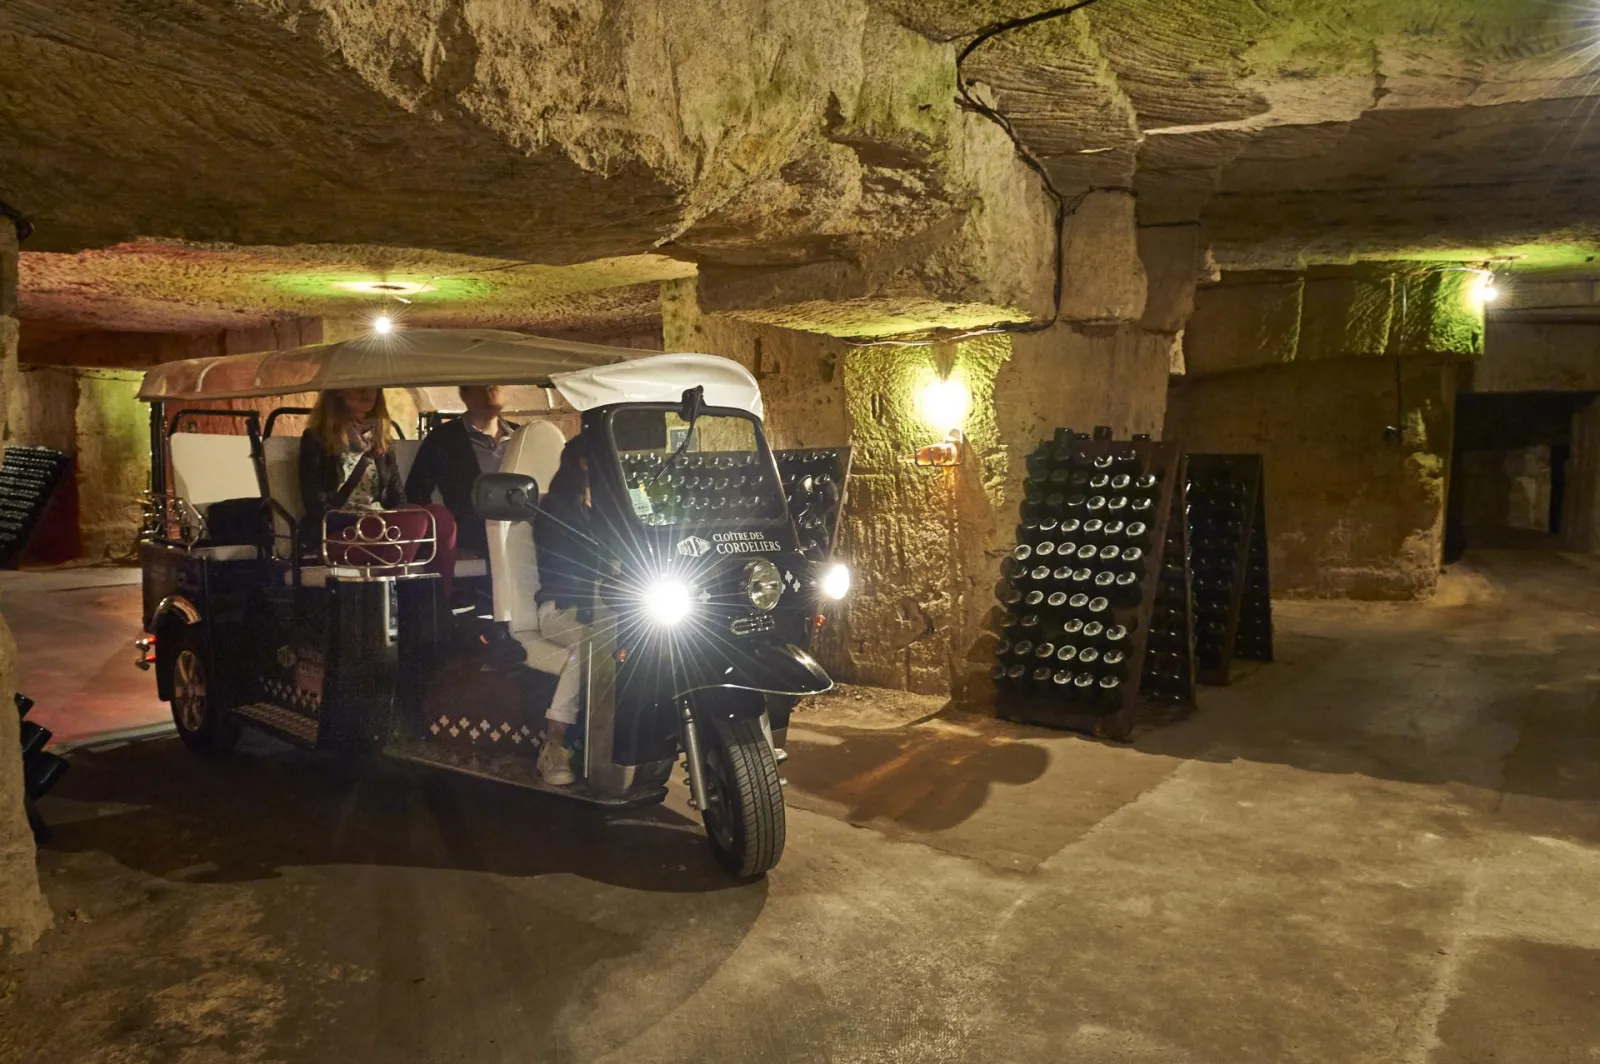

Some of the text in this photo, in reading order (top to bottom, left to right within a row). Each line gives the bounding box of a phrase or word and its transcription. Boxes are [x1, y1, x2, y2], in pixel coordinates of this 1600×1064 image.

[713, 531, 765, 542] CLOÎTRE DES
[716, 541, 781, 554] CORDELIERS
